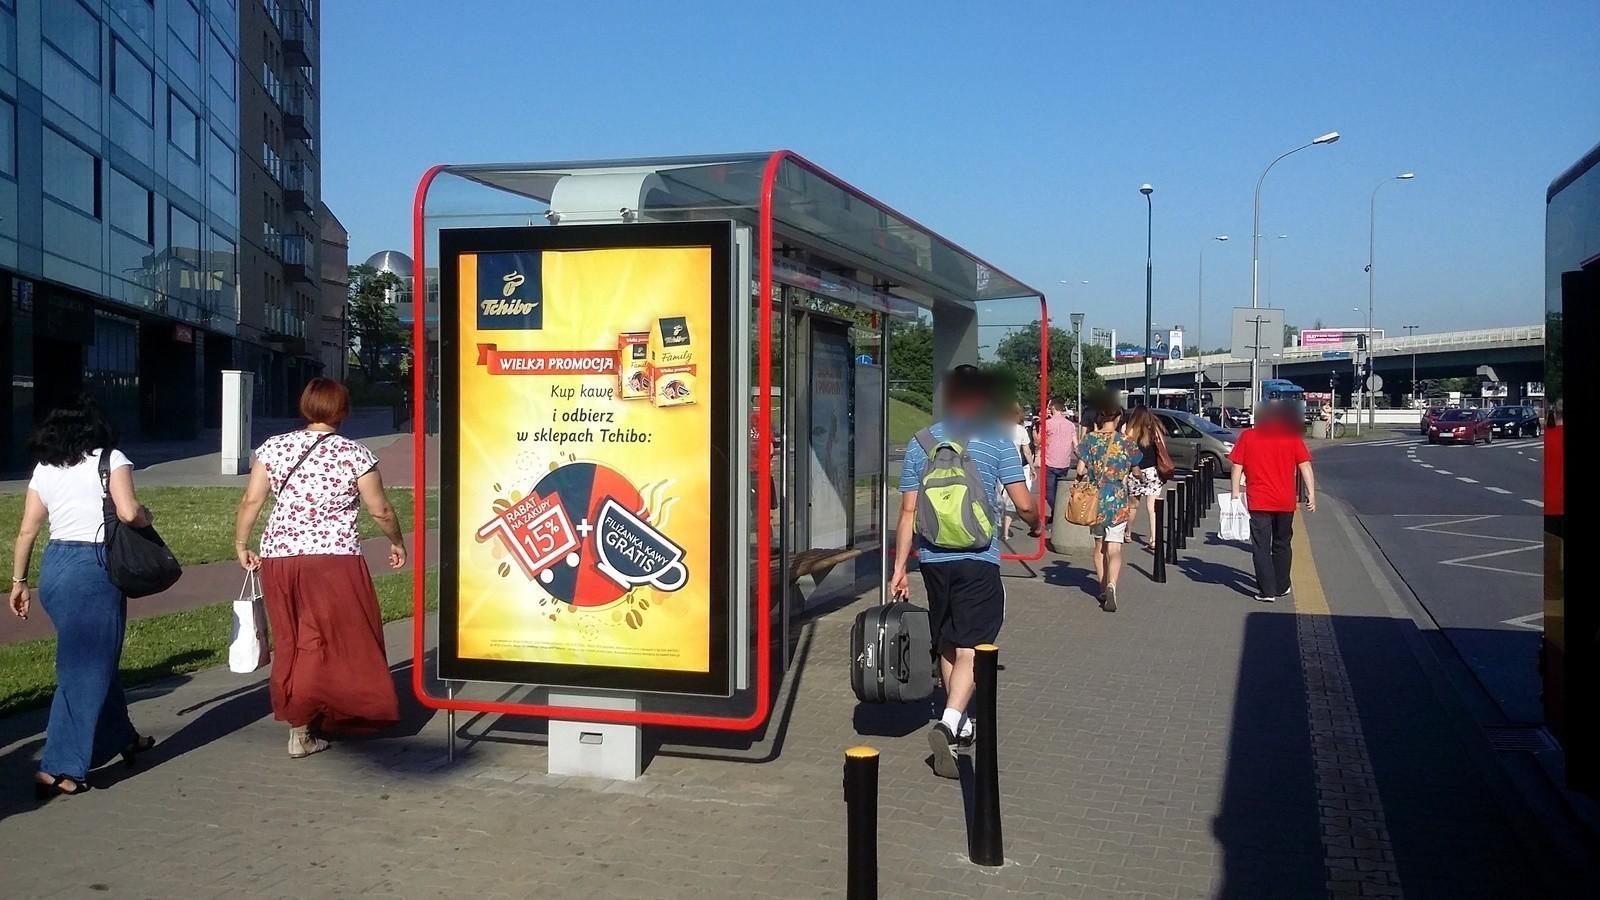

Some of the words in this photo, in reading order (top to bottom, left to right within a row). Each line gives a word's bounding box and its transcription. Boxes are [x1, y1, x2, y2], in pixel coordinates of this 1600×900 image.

[480, 299, 539, 316] Tchibo
[499, 357, 545, 371] WIELKA
[548, 357, 614, 373] PROMOCJA
[661, 351, 693, 363] Family
[550, 385, 575, 400] Kup
[580, 384, 614, 400] kawę
[552, 408, 557, 422] i
[562, 408, 614, 423] odbierz
[517, 431, 528, 442] w
[534, 427, 593, 445] sklepach
[600, 428, 652, 443] Tchibo:
[505, 496, 537, 523] RABAT
[511, 520, 525, 530] NA
[522, 499, 551, 523] ZAKUPY
[524, 519, 560, 558] 15%
[605, 516, 643, 549] FILIŻANKA
[644, 545, 669, 566] KAWY
[606, 531, 655, 572] GRATIS
